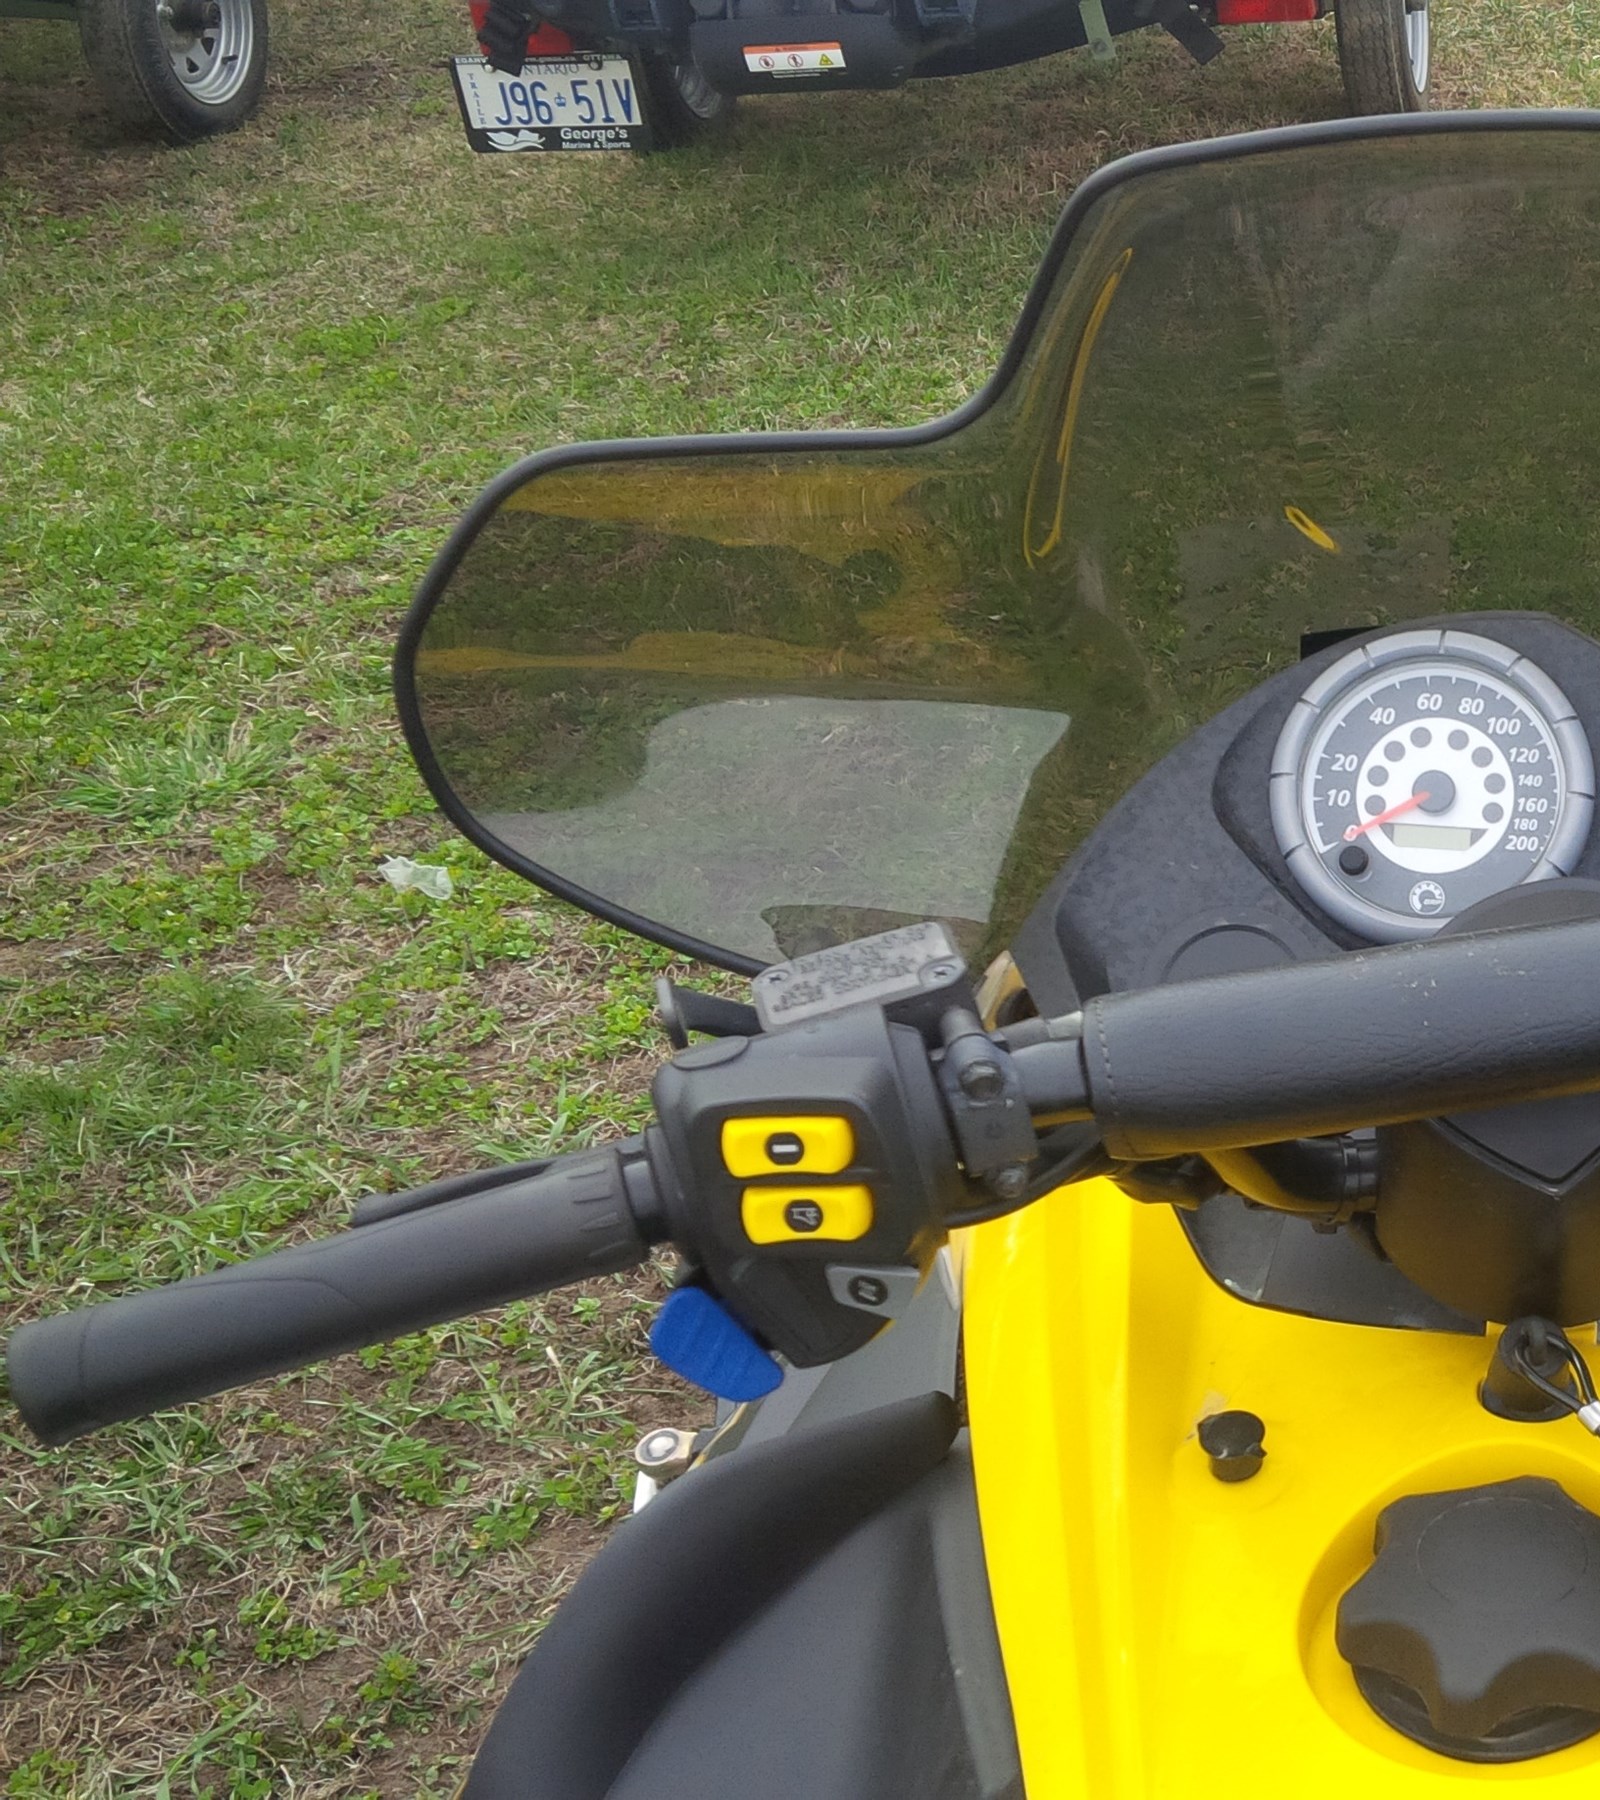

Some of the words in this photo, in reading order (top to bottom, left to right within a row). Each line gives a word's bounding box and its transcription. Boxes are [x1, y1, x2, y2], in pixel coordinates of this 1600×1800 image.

[523, 63, 580, 75] NTARIO
[466, 72, 487, 128] TRAILE
[560, 127, 628, 141] George's
[562, 141, 591, 149] Marine
[593, 141, 600, 149] &
[602, 141, 631, 149] Sports
[1416, 693, 1443, 711] 60
[1458, 697, 1484, 715] 80
[1369, 707, 1396, 725] 40
[1486, 717, 1521, 735] 100
[1331, 754, 1359, 772] 20
[1508, 747, 1540, 763] 120
[1517, 774, 1542, 788] 140
[1327, 789, 1351, 807] 10
[1516, 797, 1548, 813] 160
[1512, 818, 1538, 831] 180
[1504, 835, 1539, 851] 200
